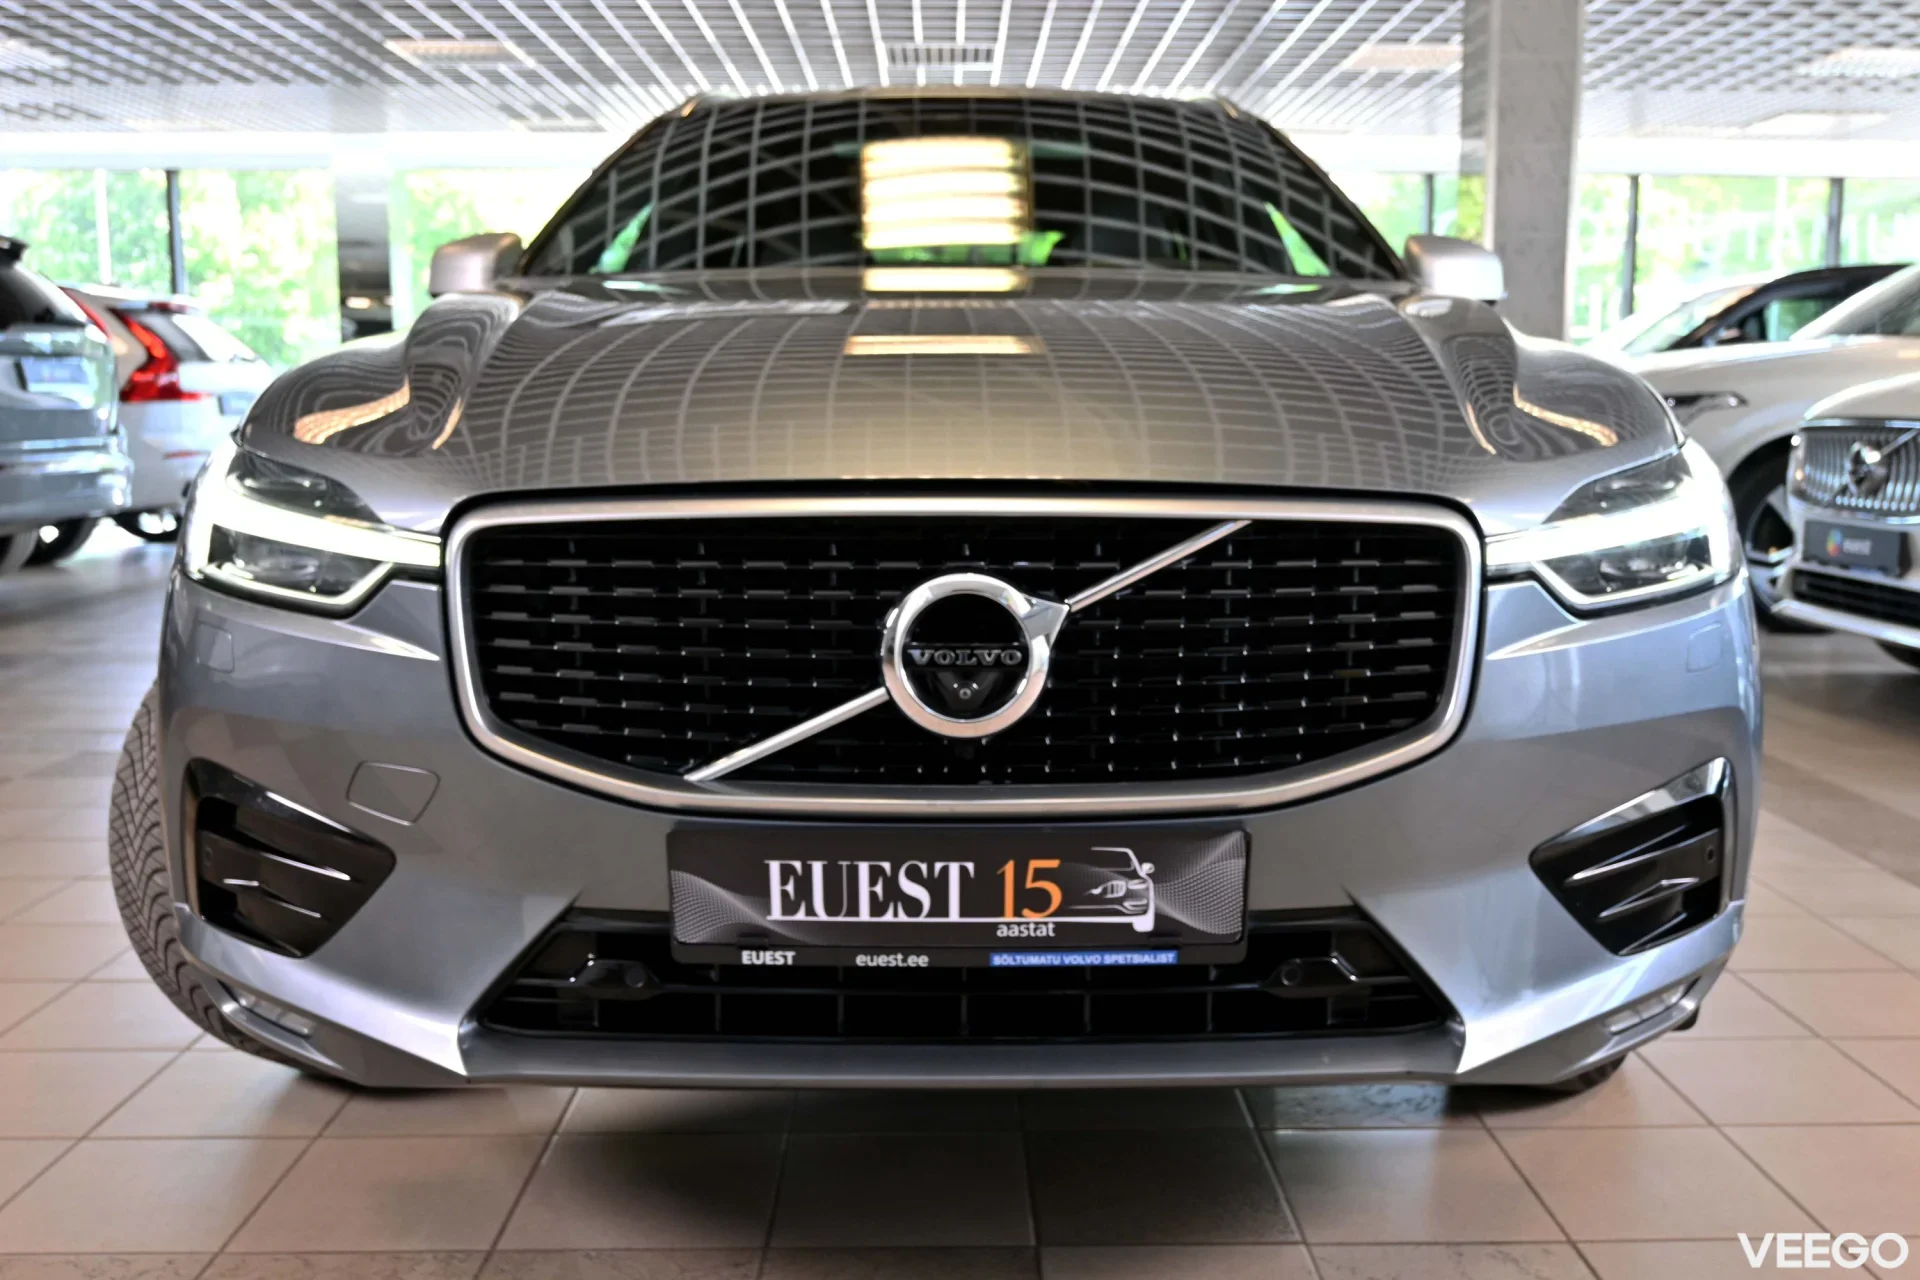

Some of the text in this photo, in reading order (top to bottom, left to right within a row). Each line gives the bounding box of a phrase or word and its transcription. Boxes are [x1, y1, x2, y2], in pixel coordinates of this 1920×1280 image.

[908, 649, 1023, 666] VOLVO
[764, 858, 1063, 920] EUEST 15
[996, 922, 1056, 938] aastat
[741, 950, 797, 966] EUEST
[855, 953, 930, 968] euest.ee
[992, 952, 1176, 966] SÕLTUMATU VOLVO SPETSIALIST
